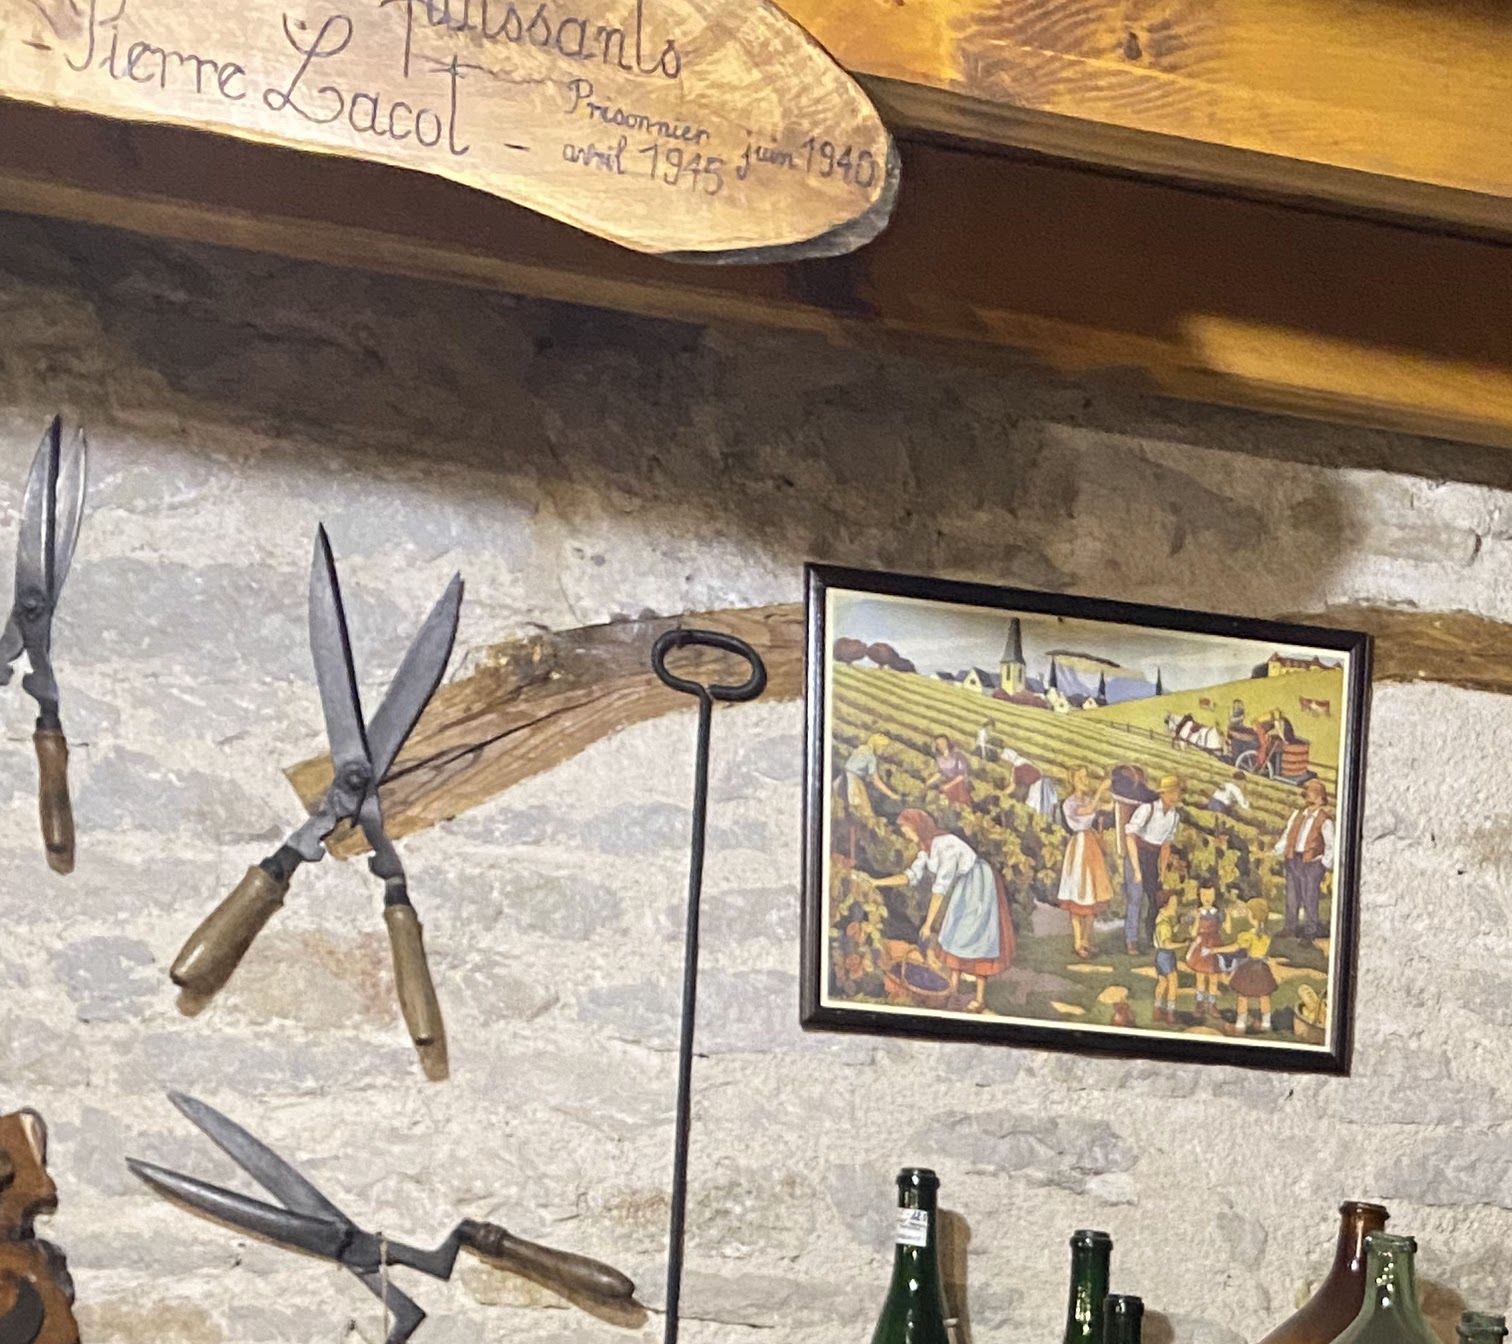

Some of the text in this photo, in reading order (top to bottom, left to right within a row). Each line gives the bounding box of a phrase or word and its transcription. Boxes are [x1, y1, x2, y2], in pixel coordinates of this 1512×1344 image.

[562, 134, 726, 196] avril 1945
[564, 78, 877, 188] Prisonnier juin 1940
